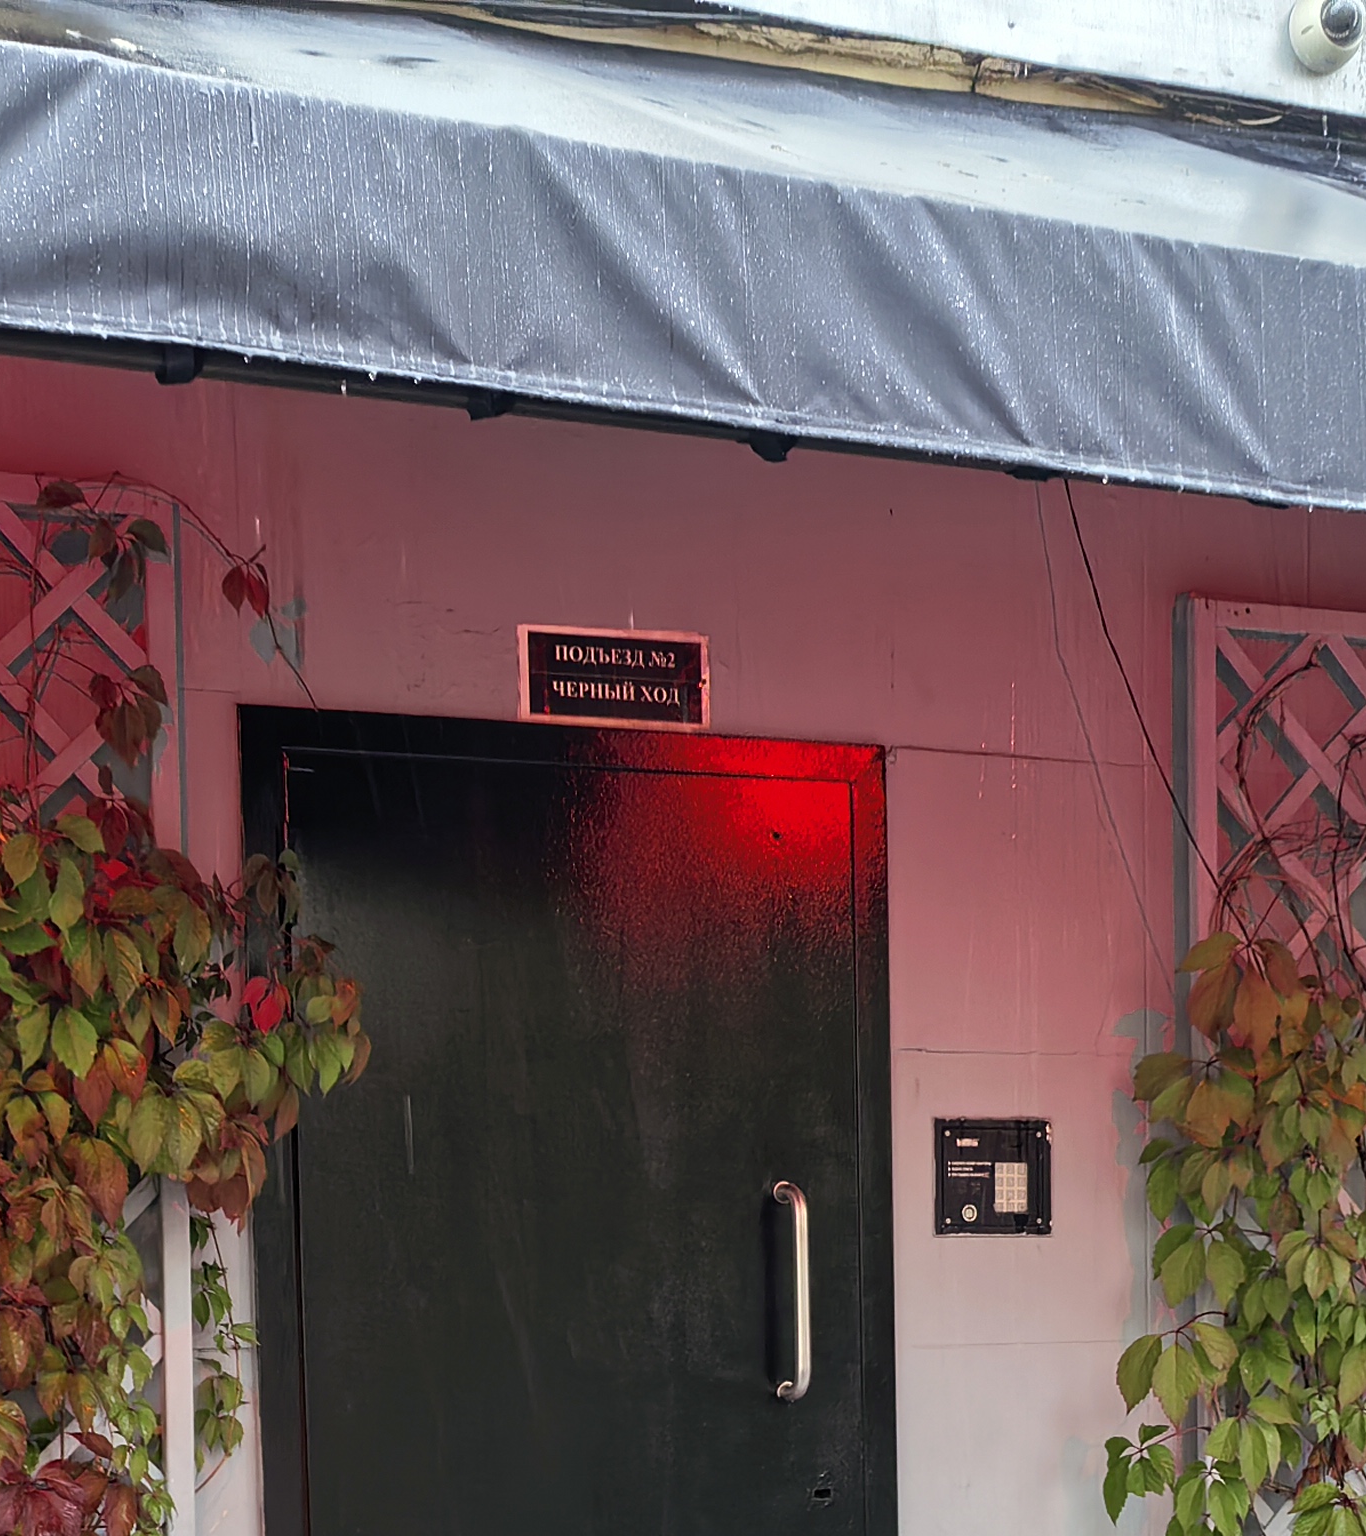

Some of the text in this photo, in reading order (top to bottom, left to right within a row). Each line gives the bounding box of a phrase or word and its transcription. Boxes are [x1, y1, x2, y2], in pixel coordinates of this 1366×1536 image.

[554, 644, 676, 669] ПОДЪЕЗД №2
[552, 680, 681, 707] ЧЕРНЫЙ ХОД
